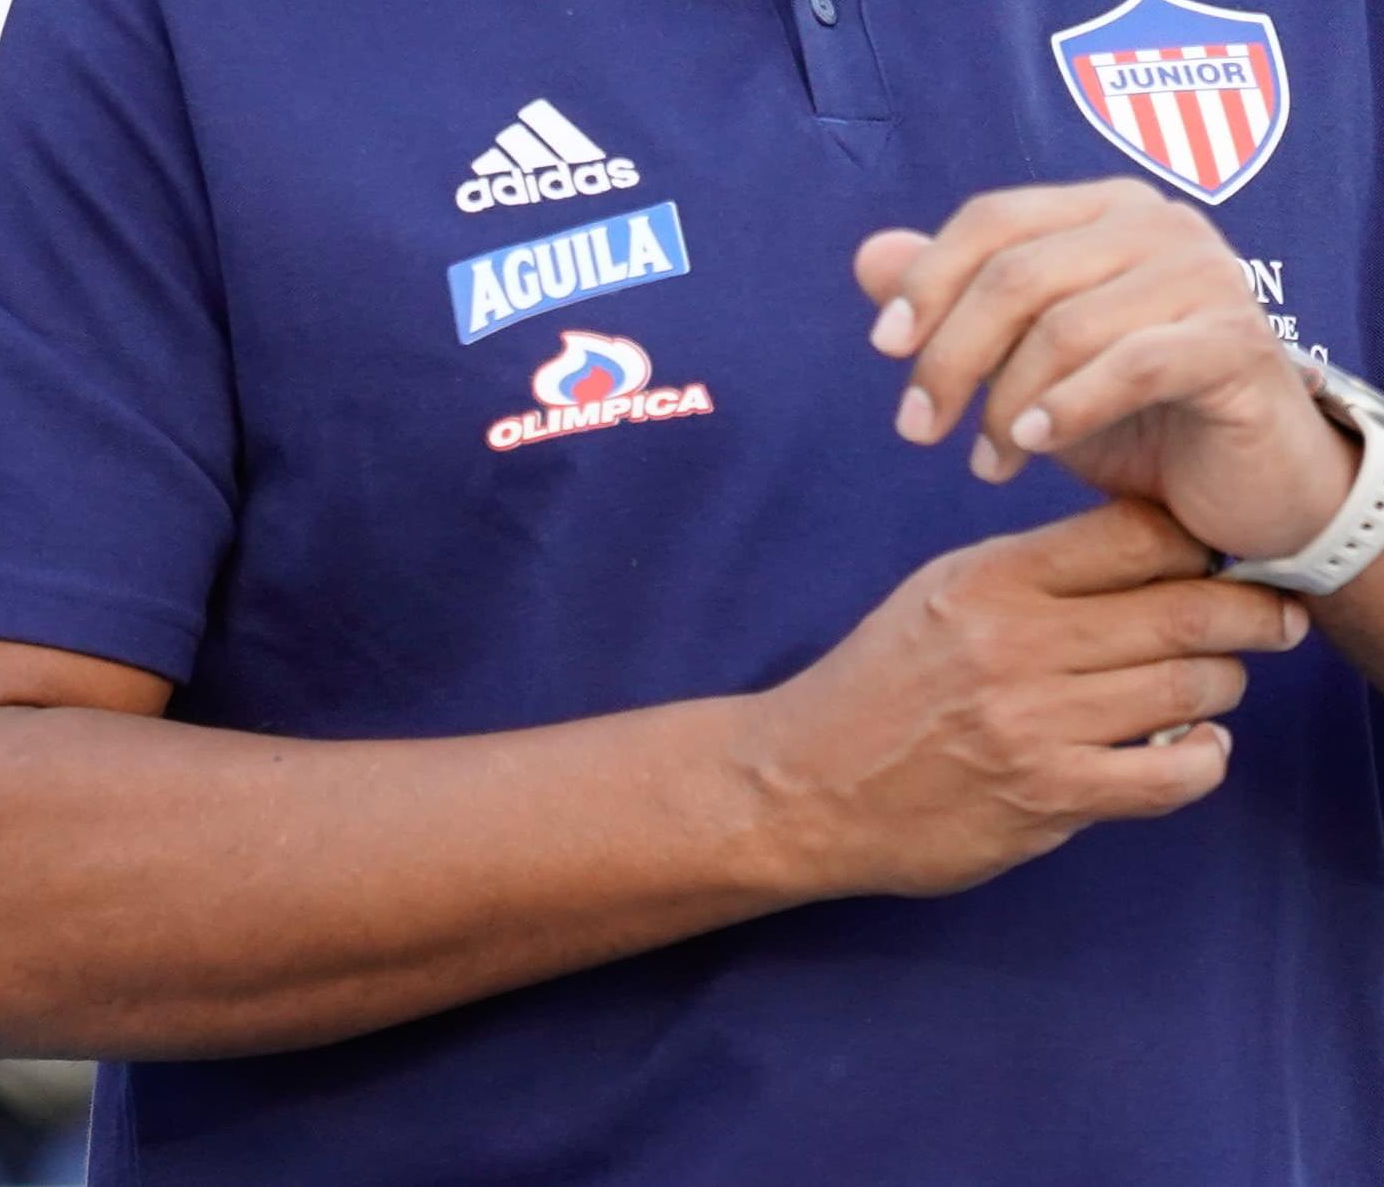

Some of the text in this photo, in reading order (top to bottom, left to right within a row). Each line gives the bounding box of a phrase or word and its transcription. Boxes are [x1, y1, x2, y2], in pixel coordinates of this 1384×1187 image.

[1109, 62, 1248, 90] JUNIOR
[455, 158, 640, 212] adidas
[469, 216, 674, 334] AGUILA
[486, 384, 714, 451] OLIMPICA
